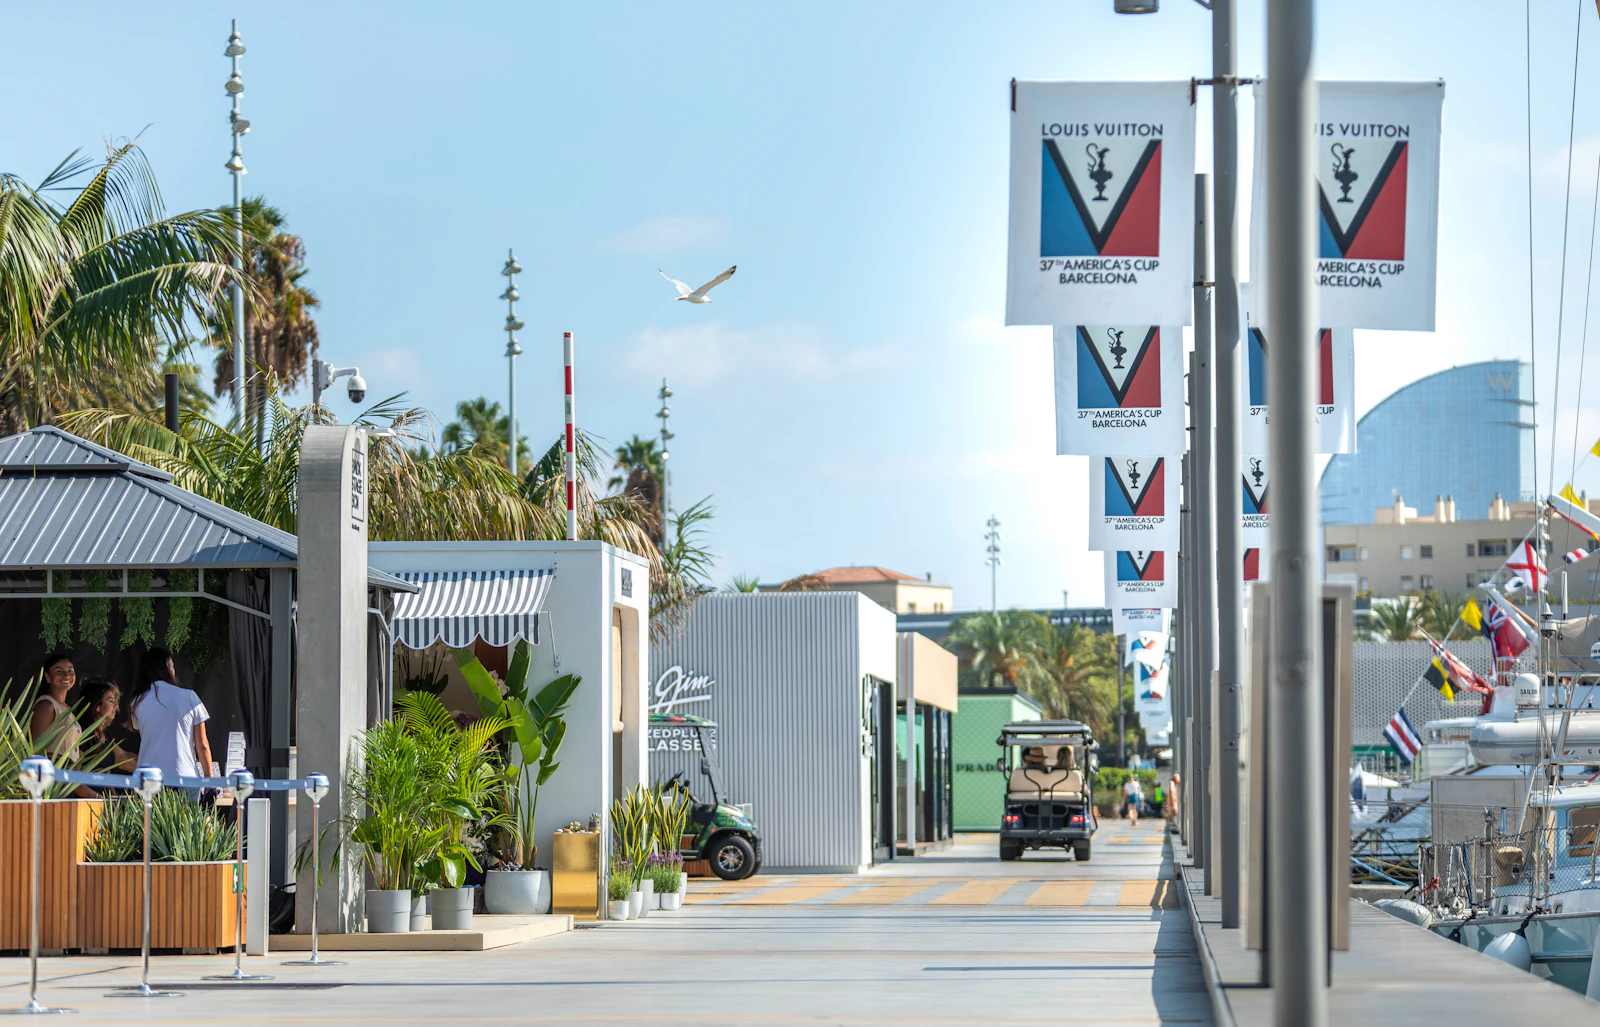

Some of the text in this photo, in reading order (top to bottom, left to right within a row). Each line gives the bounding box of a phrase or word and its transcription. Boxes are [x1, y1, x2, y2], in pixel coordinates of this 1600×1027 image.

[1041, 123, 1163, 137] LOUIS VUITTON
[1339, 123, 1409, 138] VUITTON
[1063, 259, 1131, 271] AMERICA'S
[1133, 260, 1159, 271] CUP
[1316, 261, 1405, 275] MERICA'S CUP
[1058, 272, 1138, 284] BARCELONA
[1314, 274, 1382, 288] RCELONA
[1485, 371, 1515, 392] W
[1095, 410, 1142, 419] AMERICA'S
[1144, 409, 1162, 418] CUP
[1316, 406, 1335, 415] CUP
[1092, 419, 1147, 428] BARCELONA
[956, 763, 997, 772] PRAD
